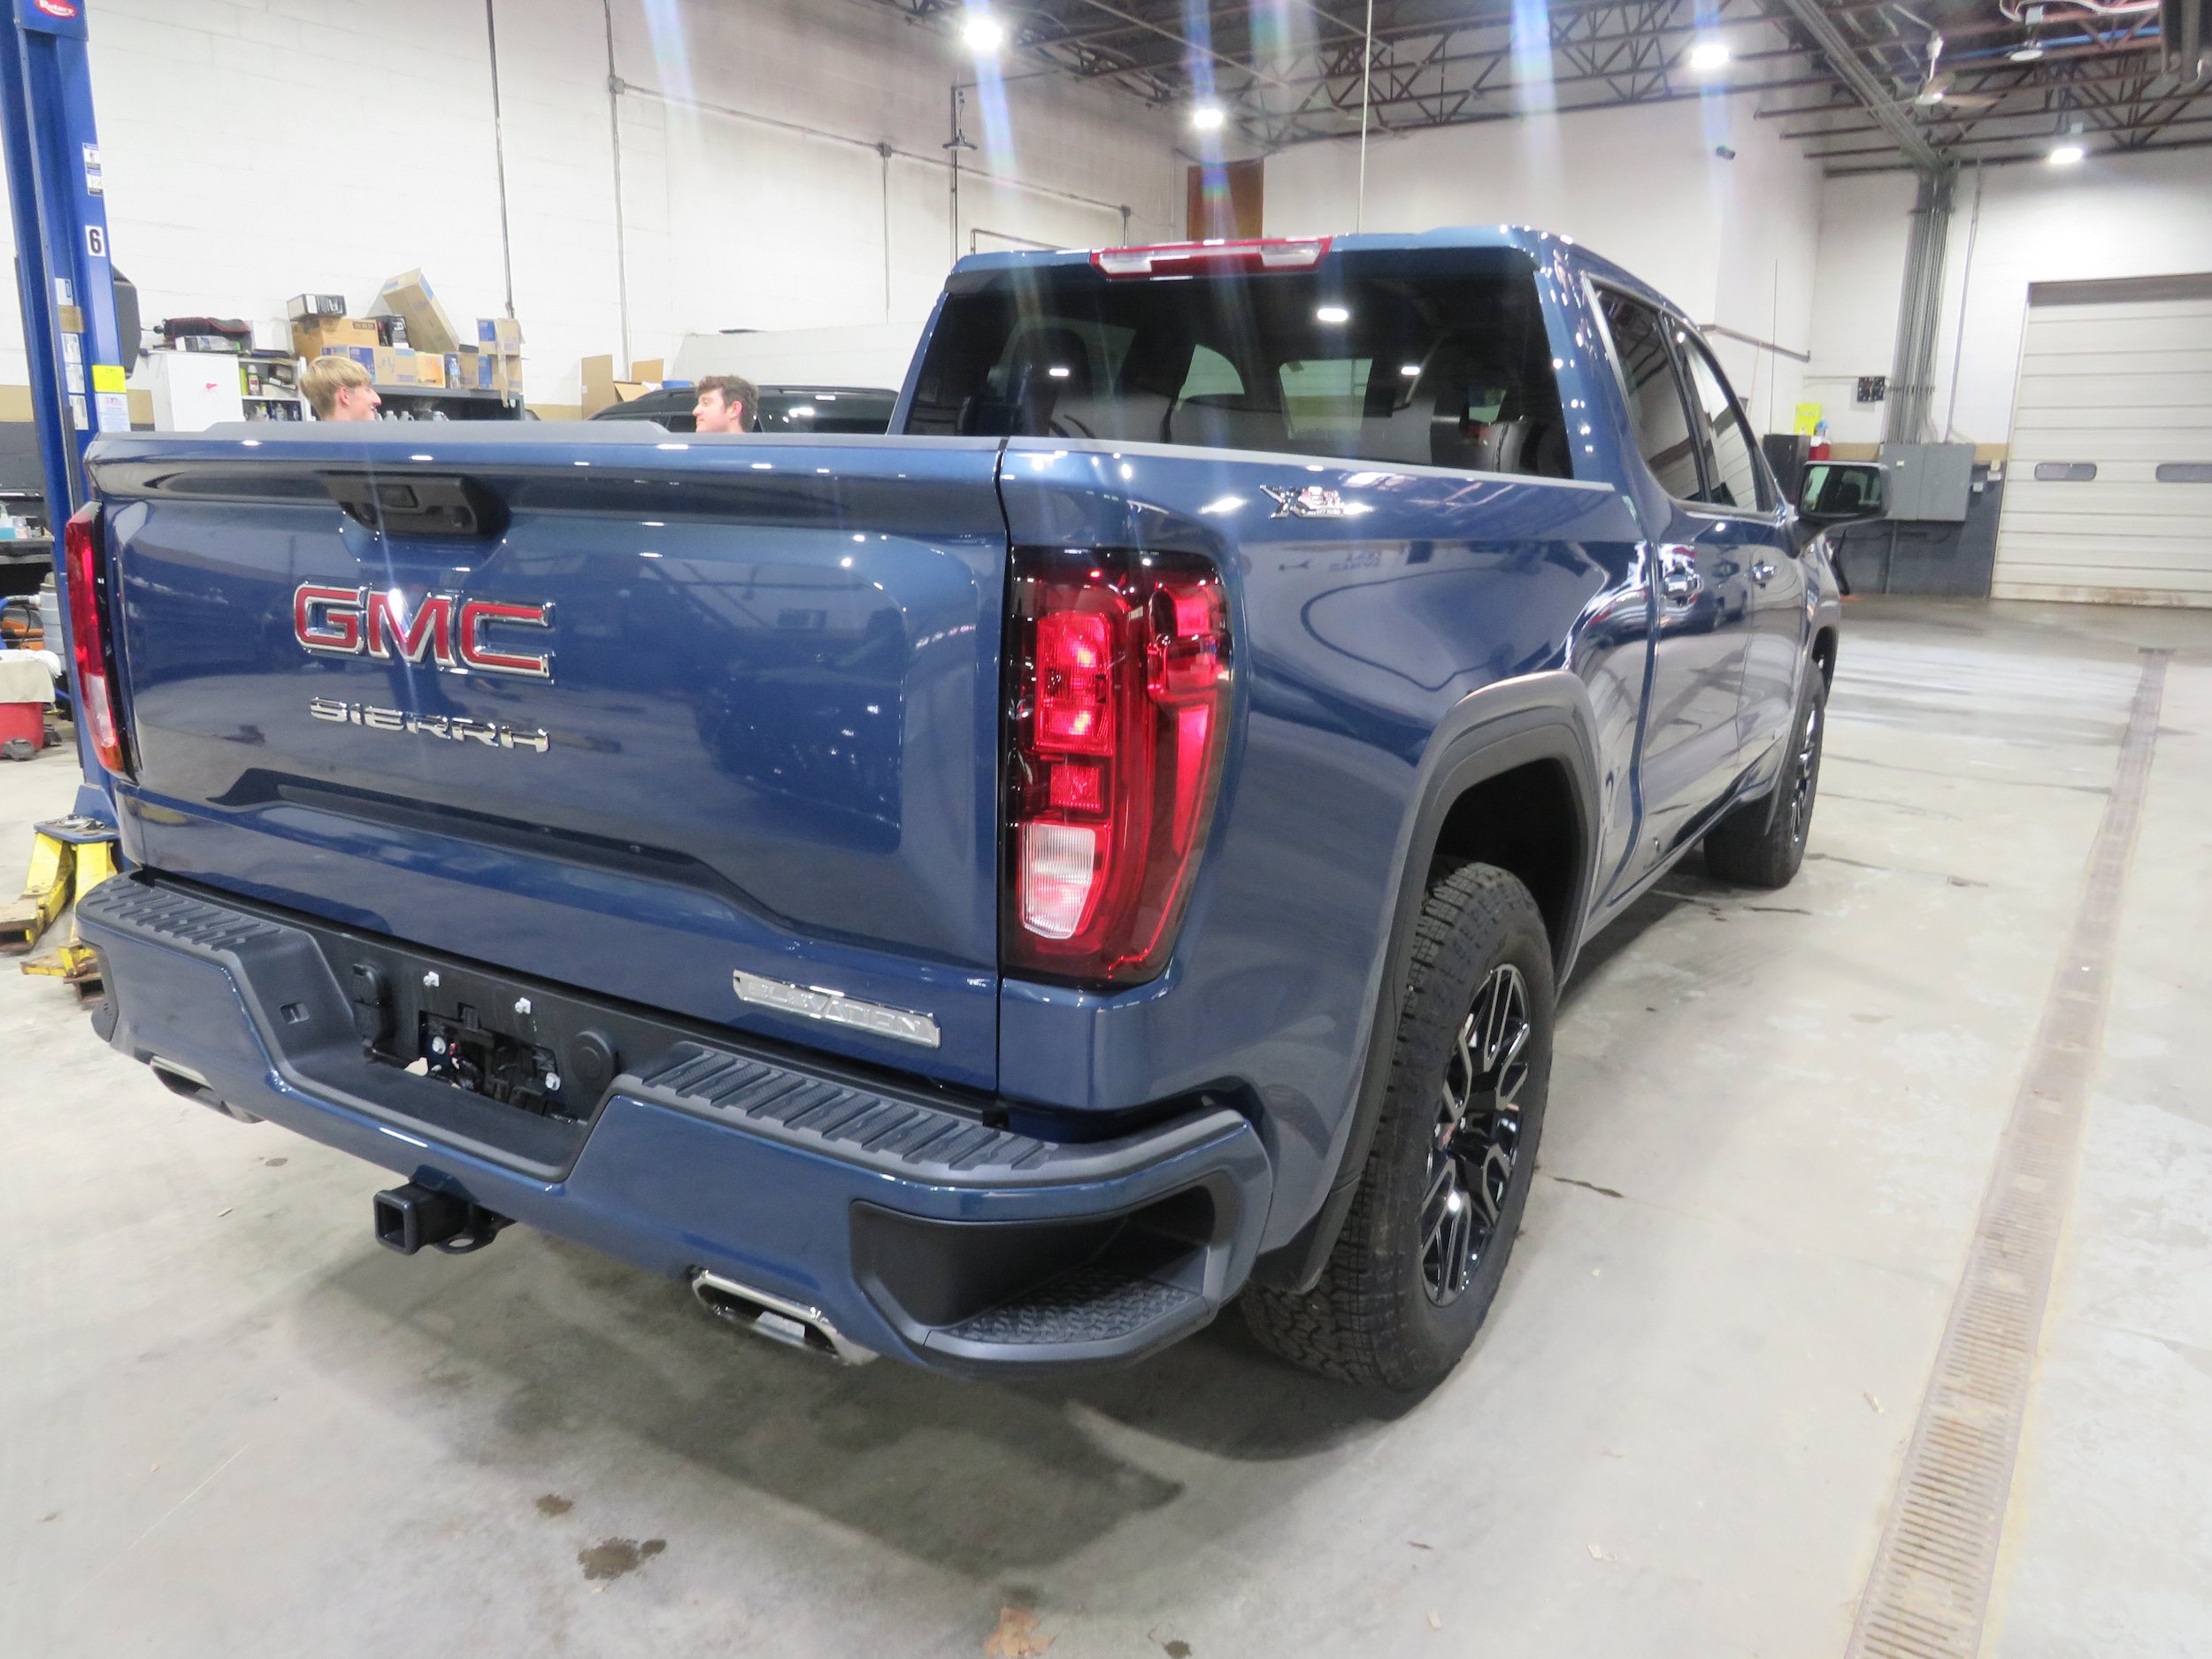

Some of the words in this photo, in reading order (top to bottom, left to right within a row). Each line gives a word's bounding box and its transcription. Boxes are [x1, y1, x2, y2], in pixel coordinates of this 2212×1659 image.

[89, 228, 103, 255] 6
[293, 582, 556, 680] GMC
[310, 696, 550, 753] SIERRA
